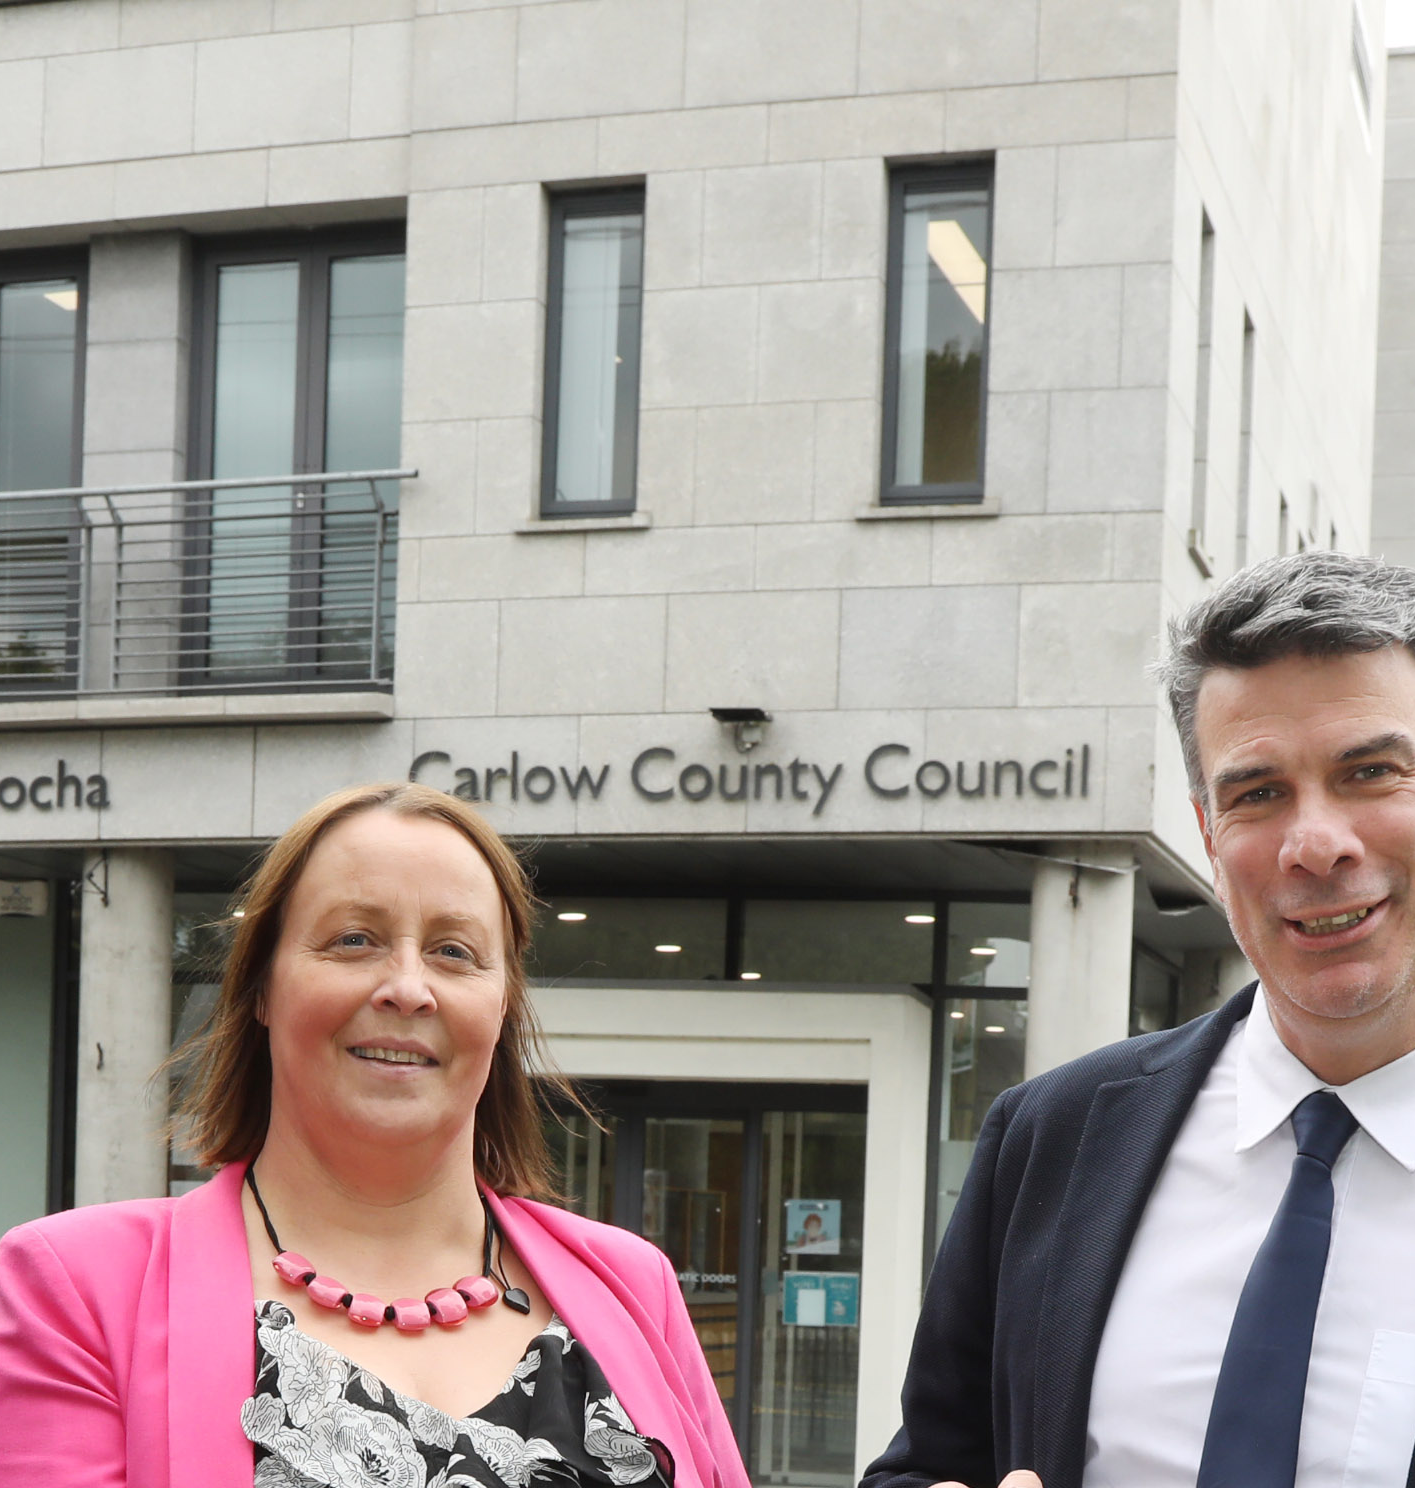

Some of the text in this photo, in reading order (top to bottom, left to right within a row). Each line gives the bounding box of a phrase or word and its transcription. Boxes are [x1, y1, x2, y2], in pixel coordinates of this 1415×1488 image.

[409, 744, 1090, 817] Carlow County Council
[701, 1273, 737, 1284] DOORS
